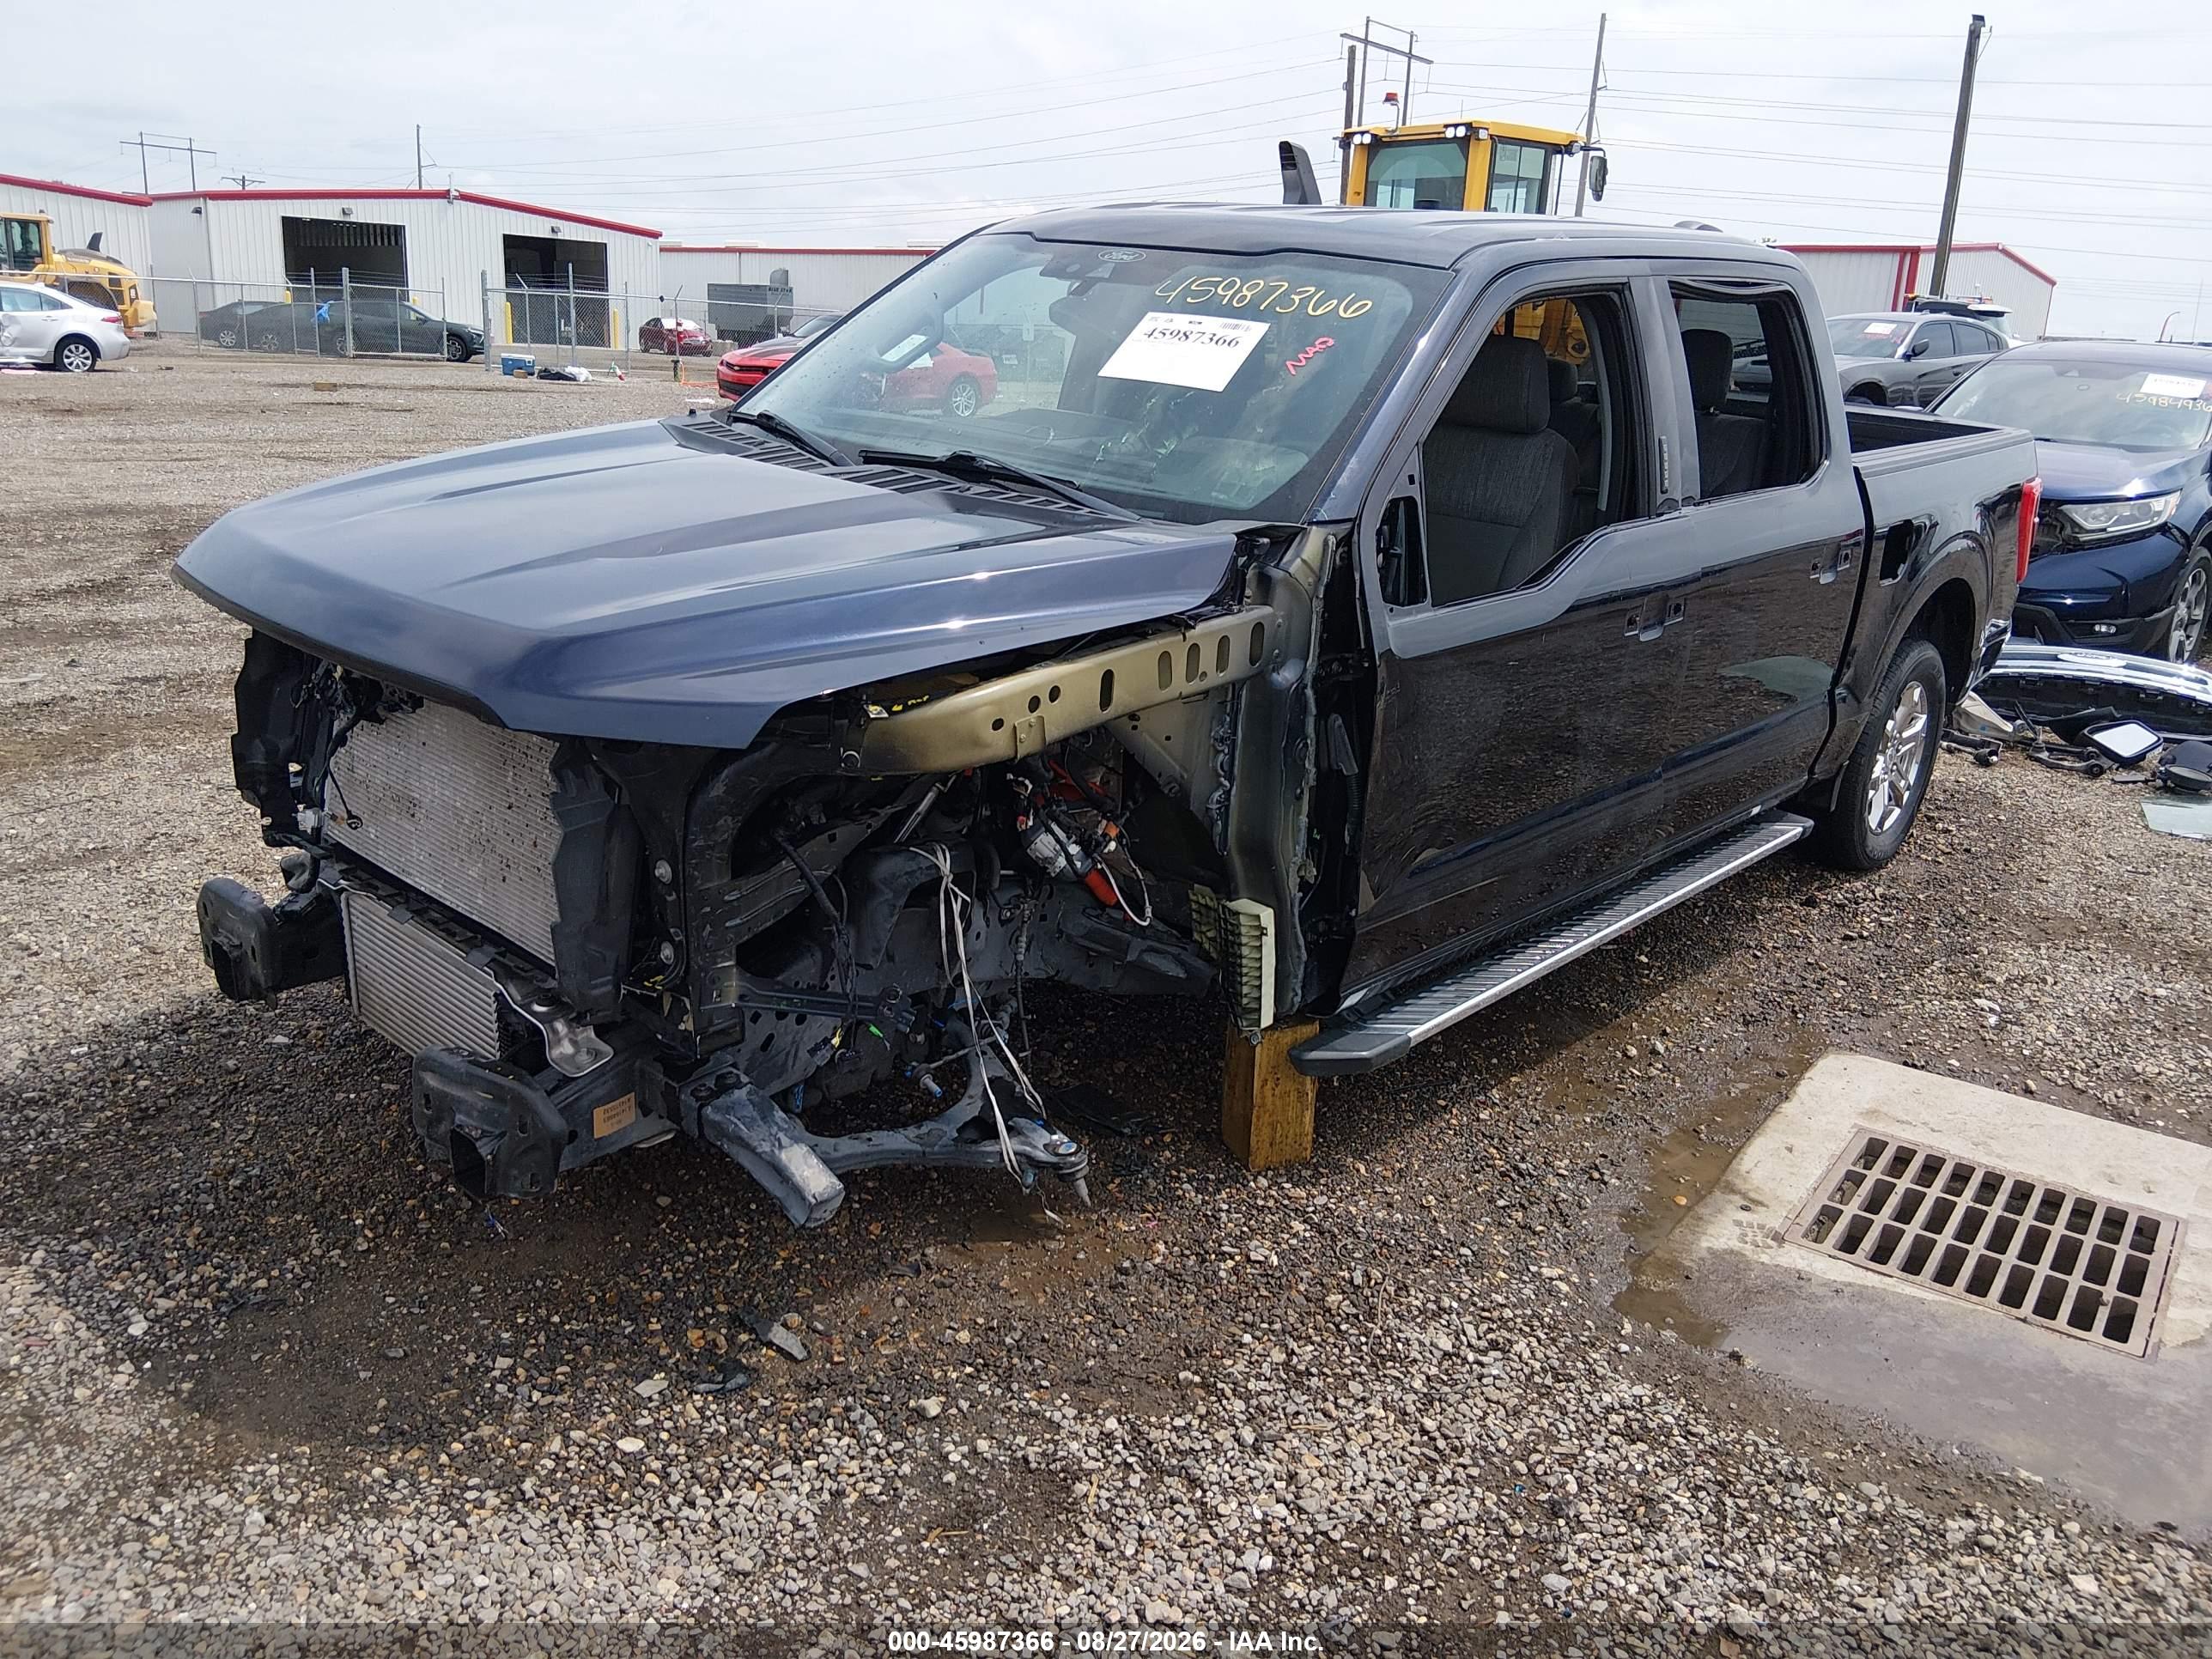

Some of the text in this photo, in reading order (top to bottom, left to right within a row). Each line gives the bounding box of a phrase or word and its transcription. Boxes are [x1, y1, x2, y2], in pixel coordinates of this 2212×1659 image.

[1155, 276, 1373, 319] 45987366
[1143, 327, 1243, 349] 45987366
[2116, 392, 2212, 412] 45984936
